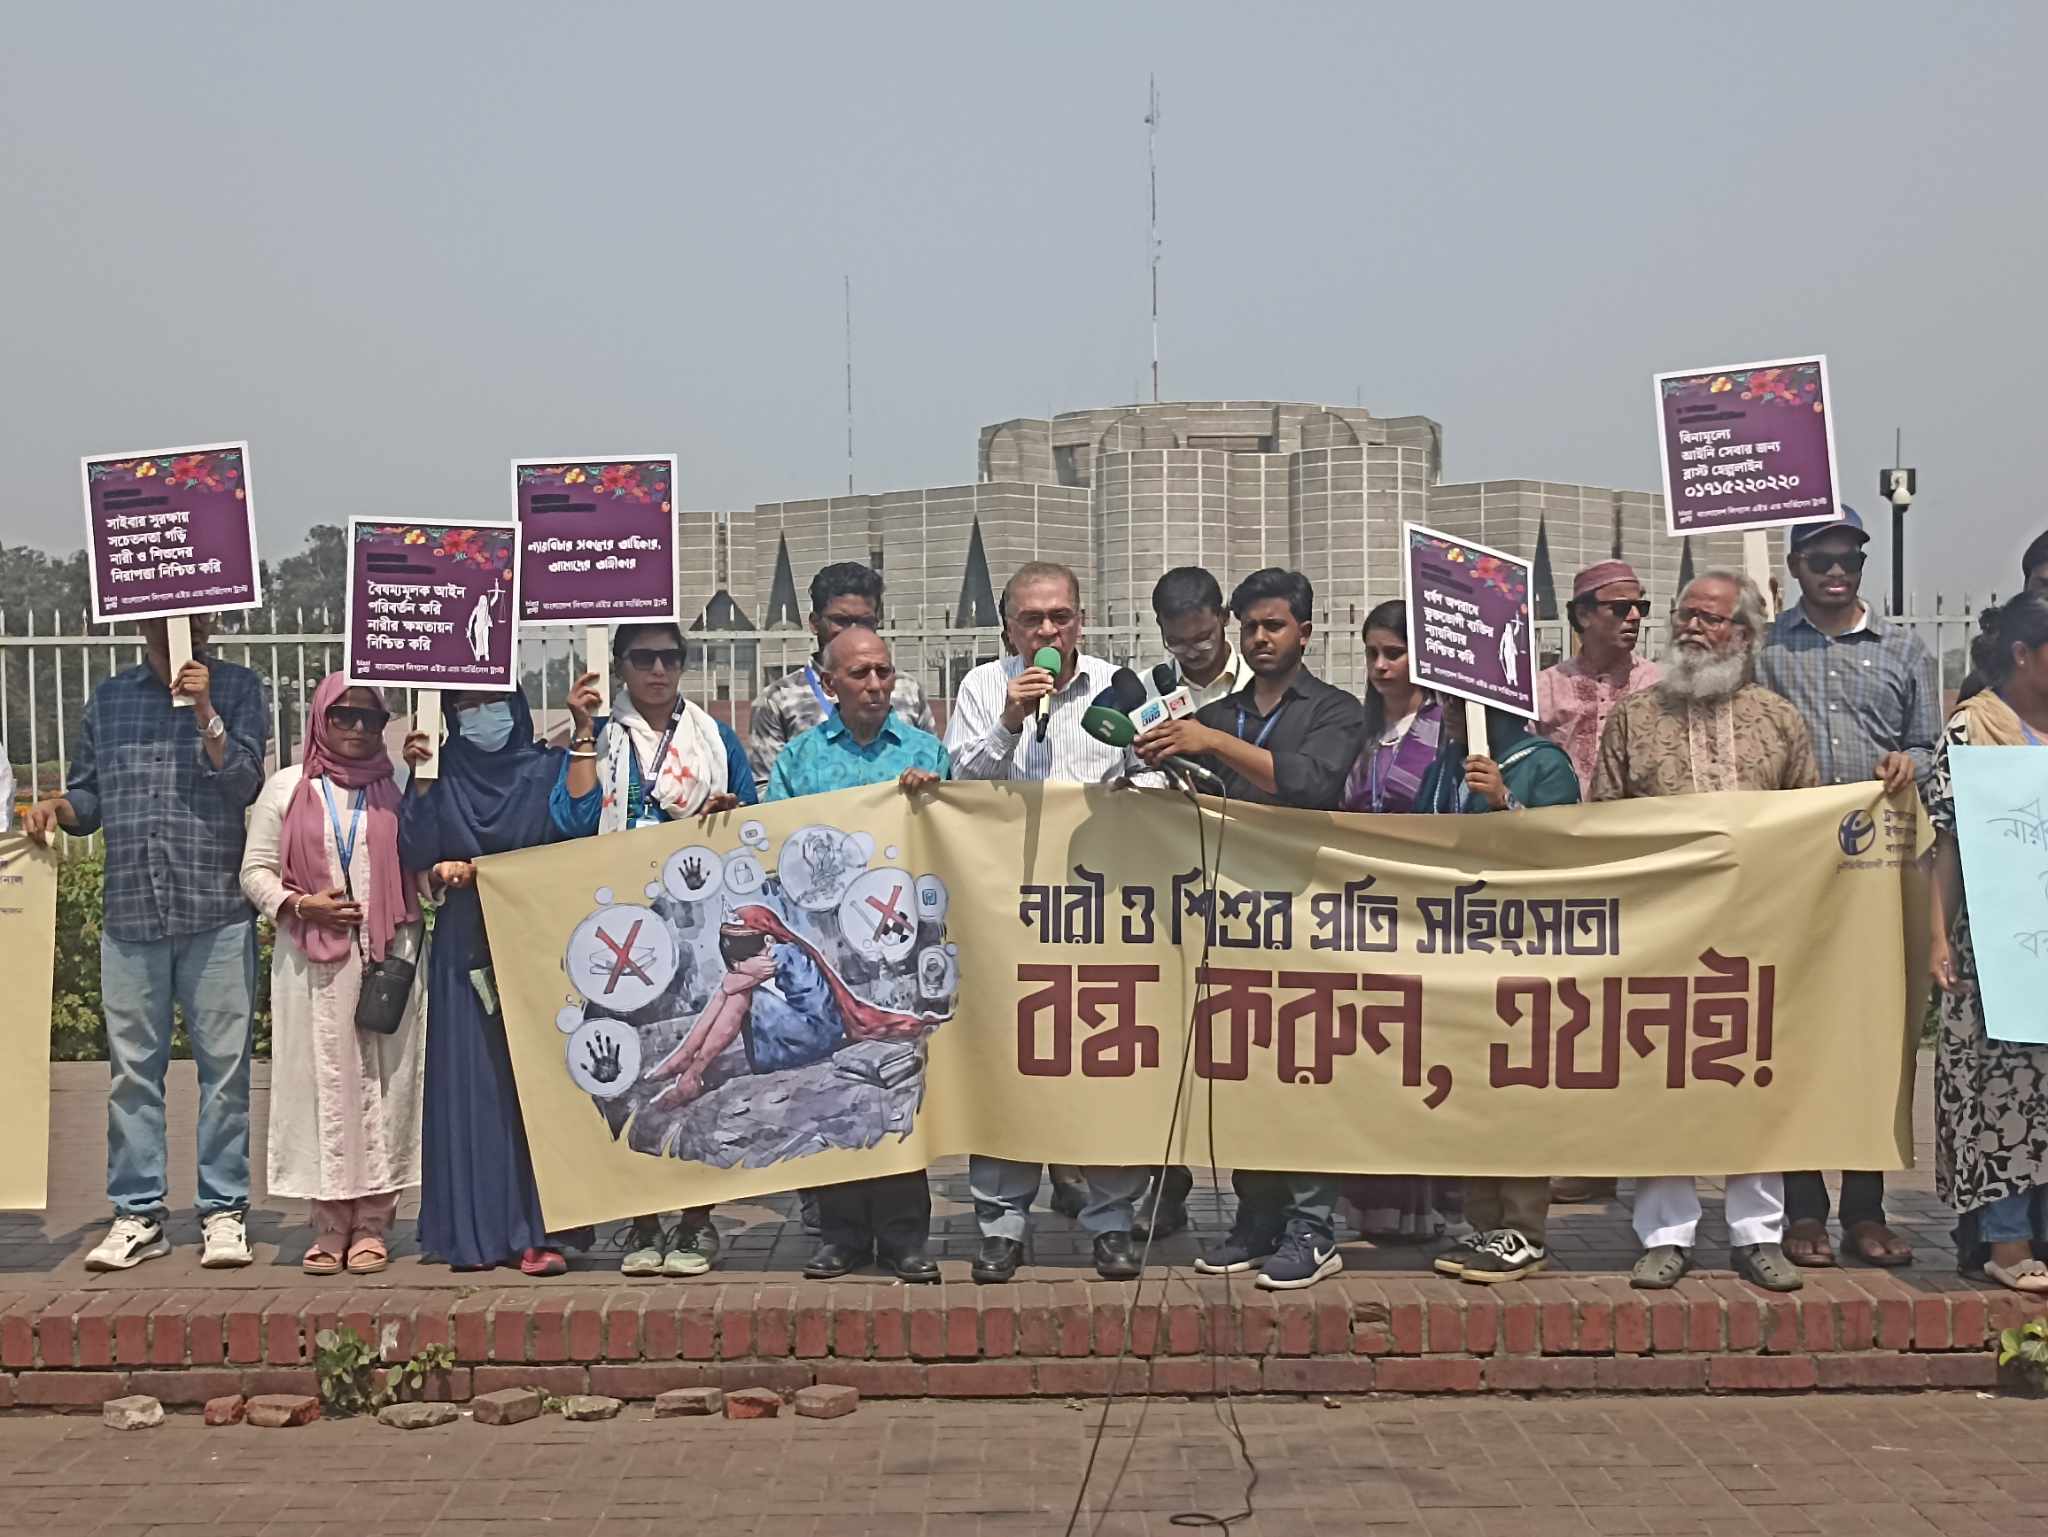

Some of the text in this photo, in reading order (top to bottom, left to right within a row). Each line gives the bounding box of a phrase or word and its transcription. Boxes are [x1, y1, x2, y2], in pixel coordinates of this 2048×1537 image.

[1679, 428, 1731, 445] বিনামূল্যে
[1681, 441, 1781, 461] আইনি সেবার জন্য
[1684, 474, 1800, 498] ০১৭১৫২২০২২০
[106, 515, 146, 531] সাইবার
[108, 532, 161, 549] সচেতনতা
[110, 549, 133, 567] নারী
[137, 552, 147, 563] ও
[158, 563, 197, 579] নিশ্চিত
[198, 558, 222, 575] করি
[367, 580, 467, 600] বৈষম্যমূলক আইন
[367, 598, 443, 616] পরিবর্তন করি
[366, 616, 454, 634] নারীর ক্ষমতায়ন
[366, 635, 432, 652] নিশ্চিত করি
[1019, 863, 1620, 956] নারী ও শিশুর প্রতি সহিংসতা
[1017, 947, 1776, 1110] বন্ধ করুন, এখনই!
